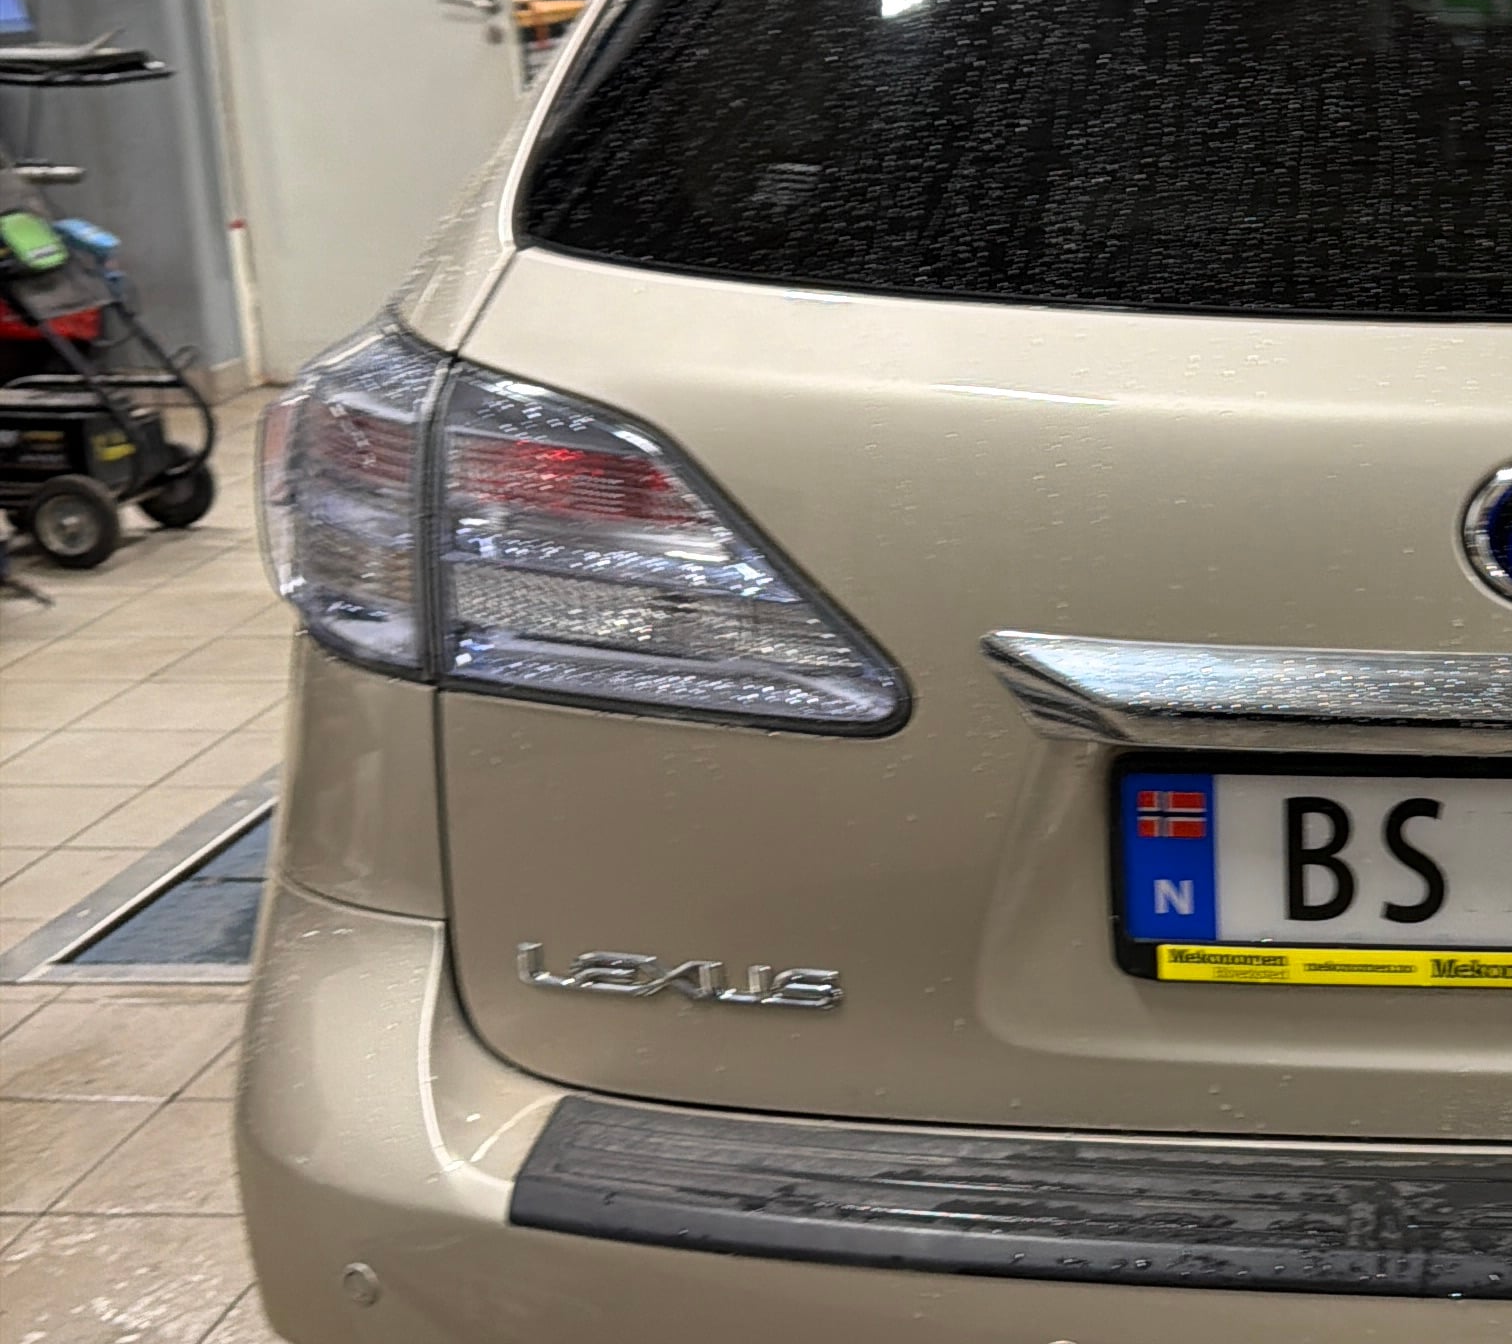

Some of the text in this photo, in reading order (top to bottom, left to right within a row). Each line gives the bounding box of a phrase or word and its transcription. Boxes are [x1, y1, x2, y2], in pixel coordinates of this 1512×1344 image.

[1282, 795, 1448, 924] BS
[1154, 878, 1194, 915] N
[516, 941, 846, 1009] LEXUS
